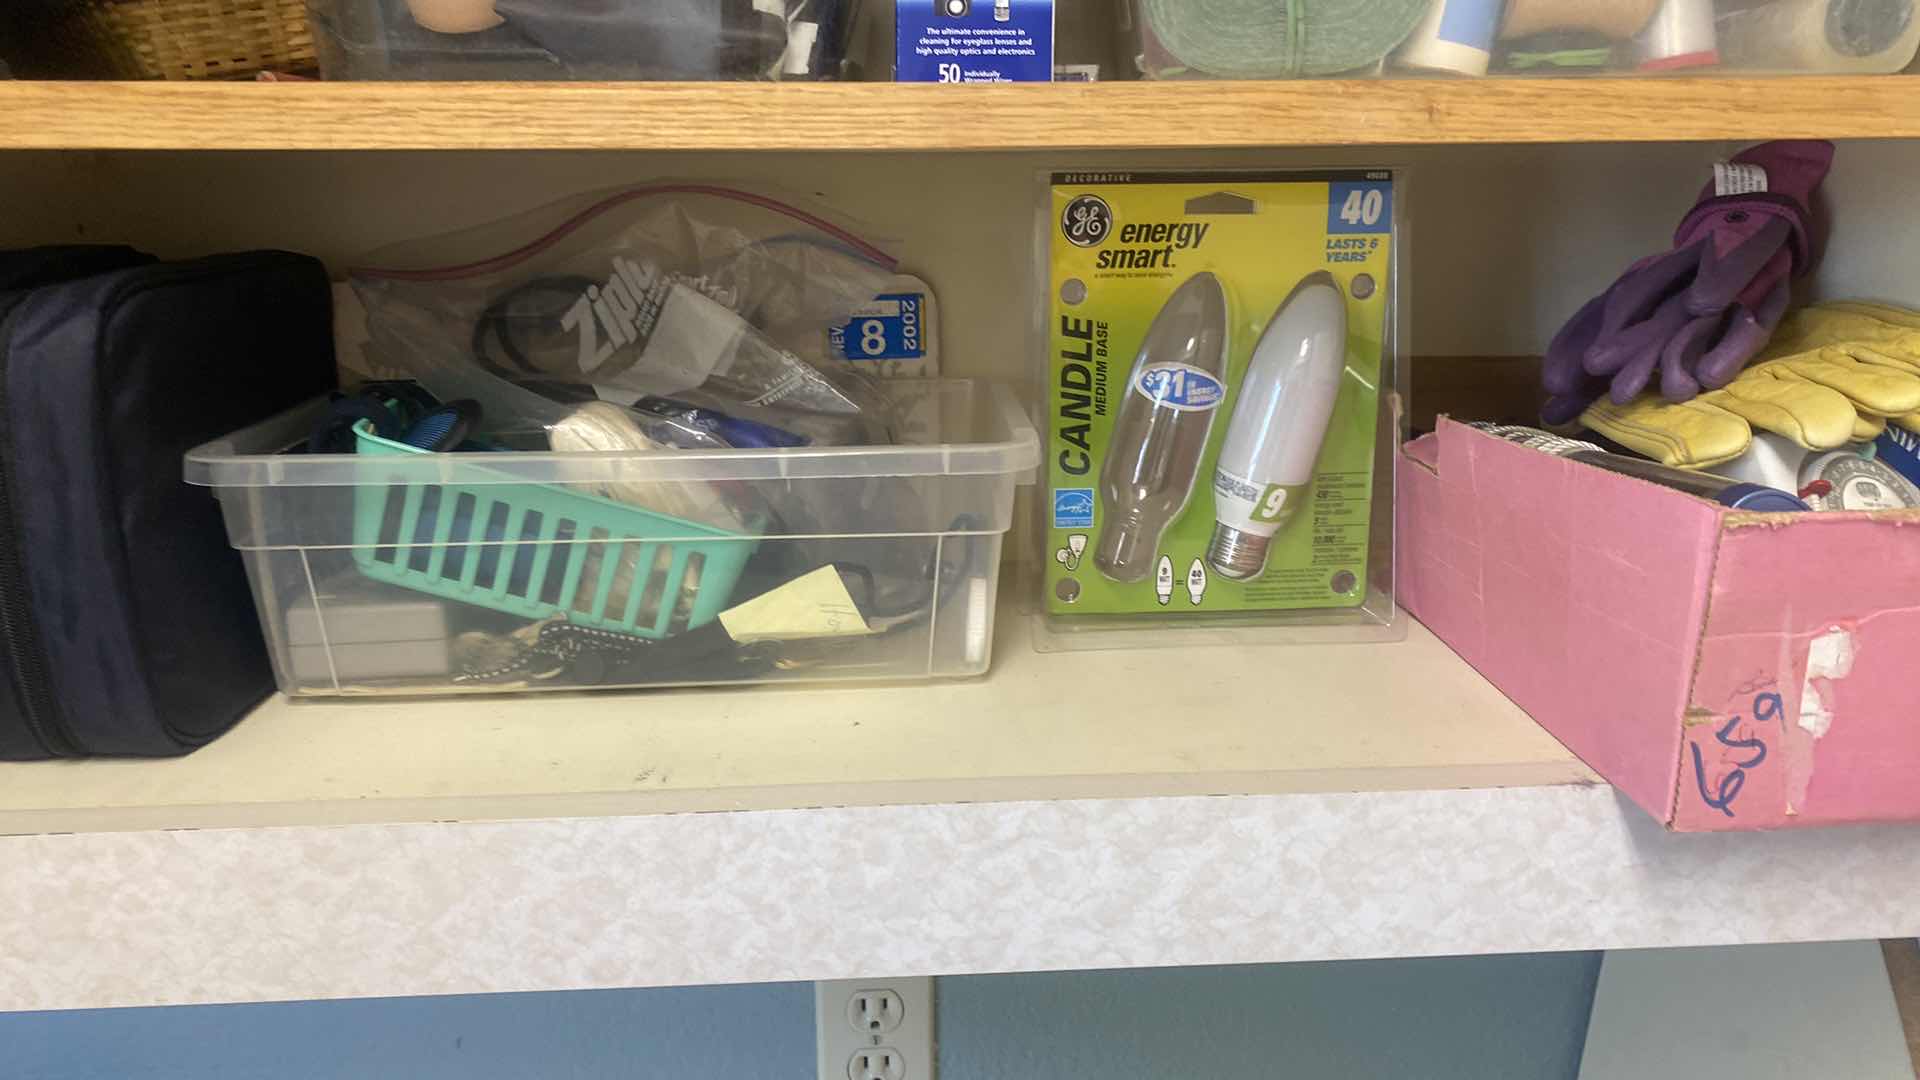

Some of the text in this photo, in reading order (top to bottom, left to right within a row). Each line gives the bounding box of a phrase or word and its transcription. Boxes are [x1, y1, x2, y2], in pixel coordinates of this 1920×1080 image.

[919, 38, 949, 46] cleaning
[951, 37, 961, 45] for
[963, 38, 993, 46] eyeglass
[926, 27, 940, 35] The
[916, 46, 1035, 56] high quality optics and electronics
[939, 63, 1000, 82] 50 Individually
[1065, 174, 1133, 182] DECORATIVE
[1340, 189, 1383, 225] 40
[1120, 223, 1210, 249] energy
[1327, 239, 1367, 250] LASTS
[1096, 245, 1176, 269] smart.
[861, 320, 886, 356] 8
[901, 300, 917, 352] 2002
[1095, 320, 1108, 416] MEDIUM BASE
[1059, 315, 1093, 476] CANDLE
[1146, 370, 1185, 400] $31
[1262, 488, 1287, 518] 9
